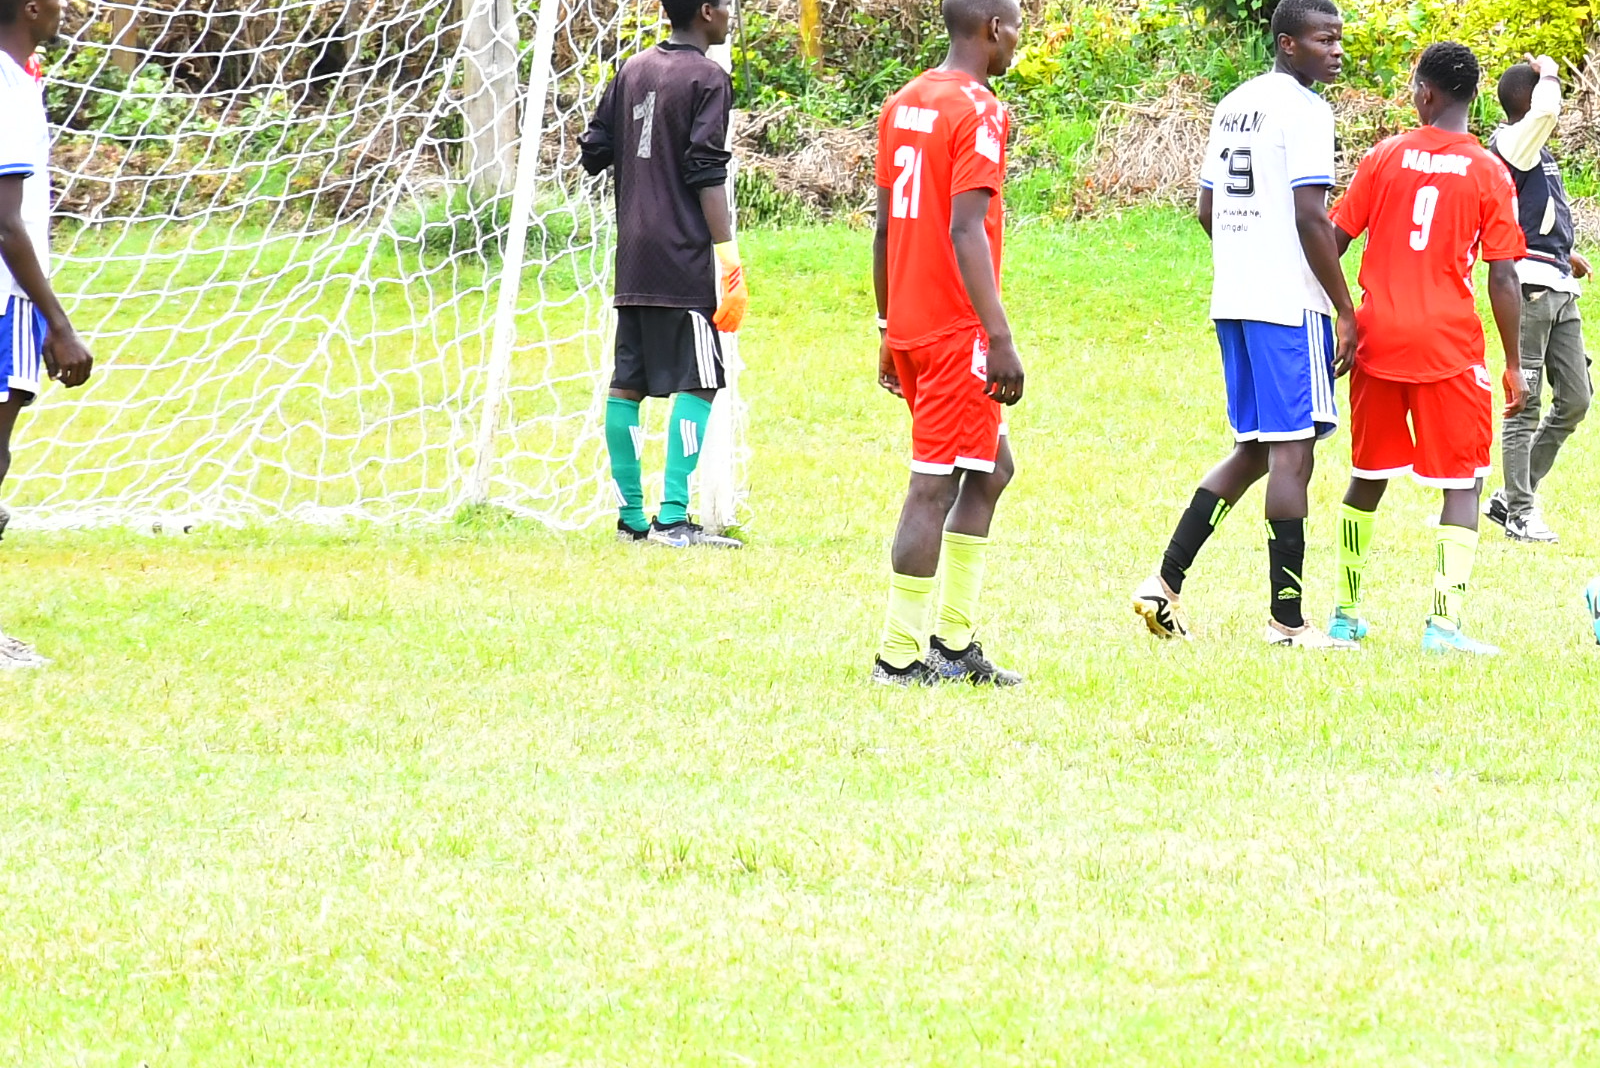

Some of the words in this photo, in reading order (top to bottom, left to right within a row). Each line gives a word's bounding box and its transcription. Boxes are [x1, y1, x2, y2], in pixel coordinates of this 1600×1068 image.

[632, 90, 656, 159] 1
[892, 145, 922, 219] 21
[1409, 185, 1439, 251] 9
